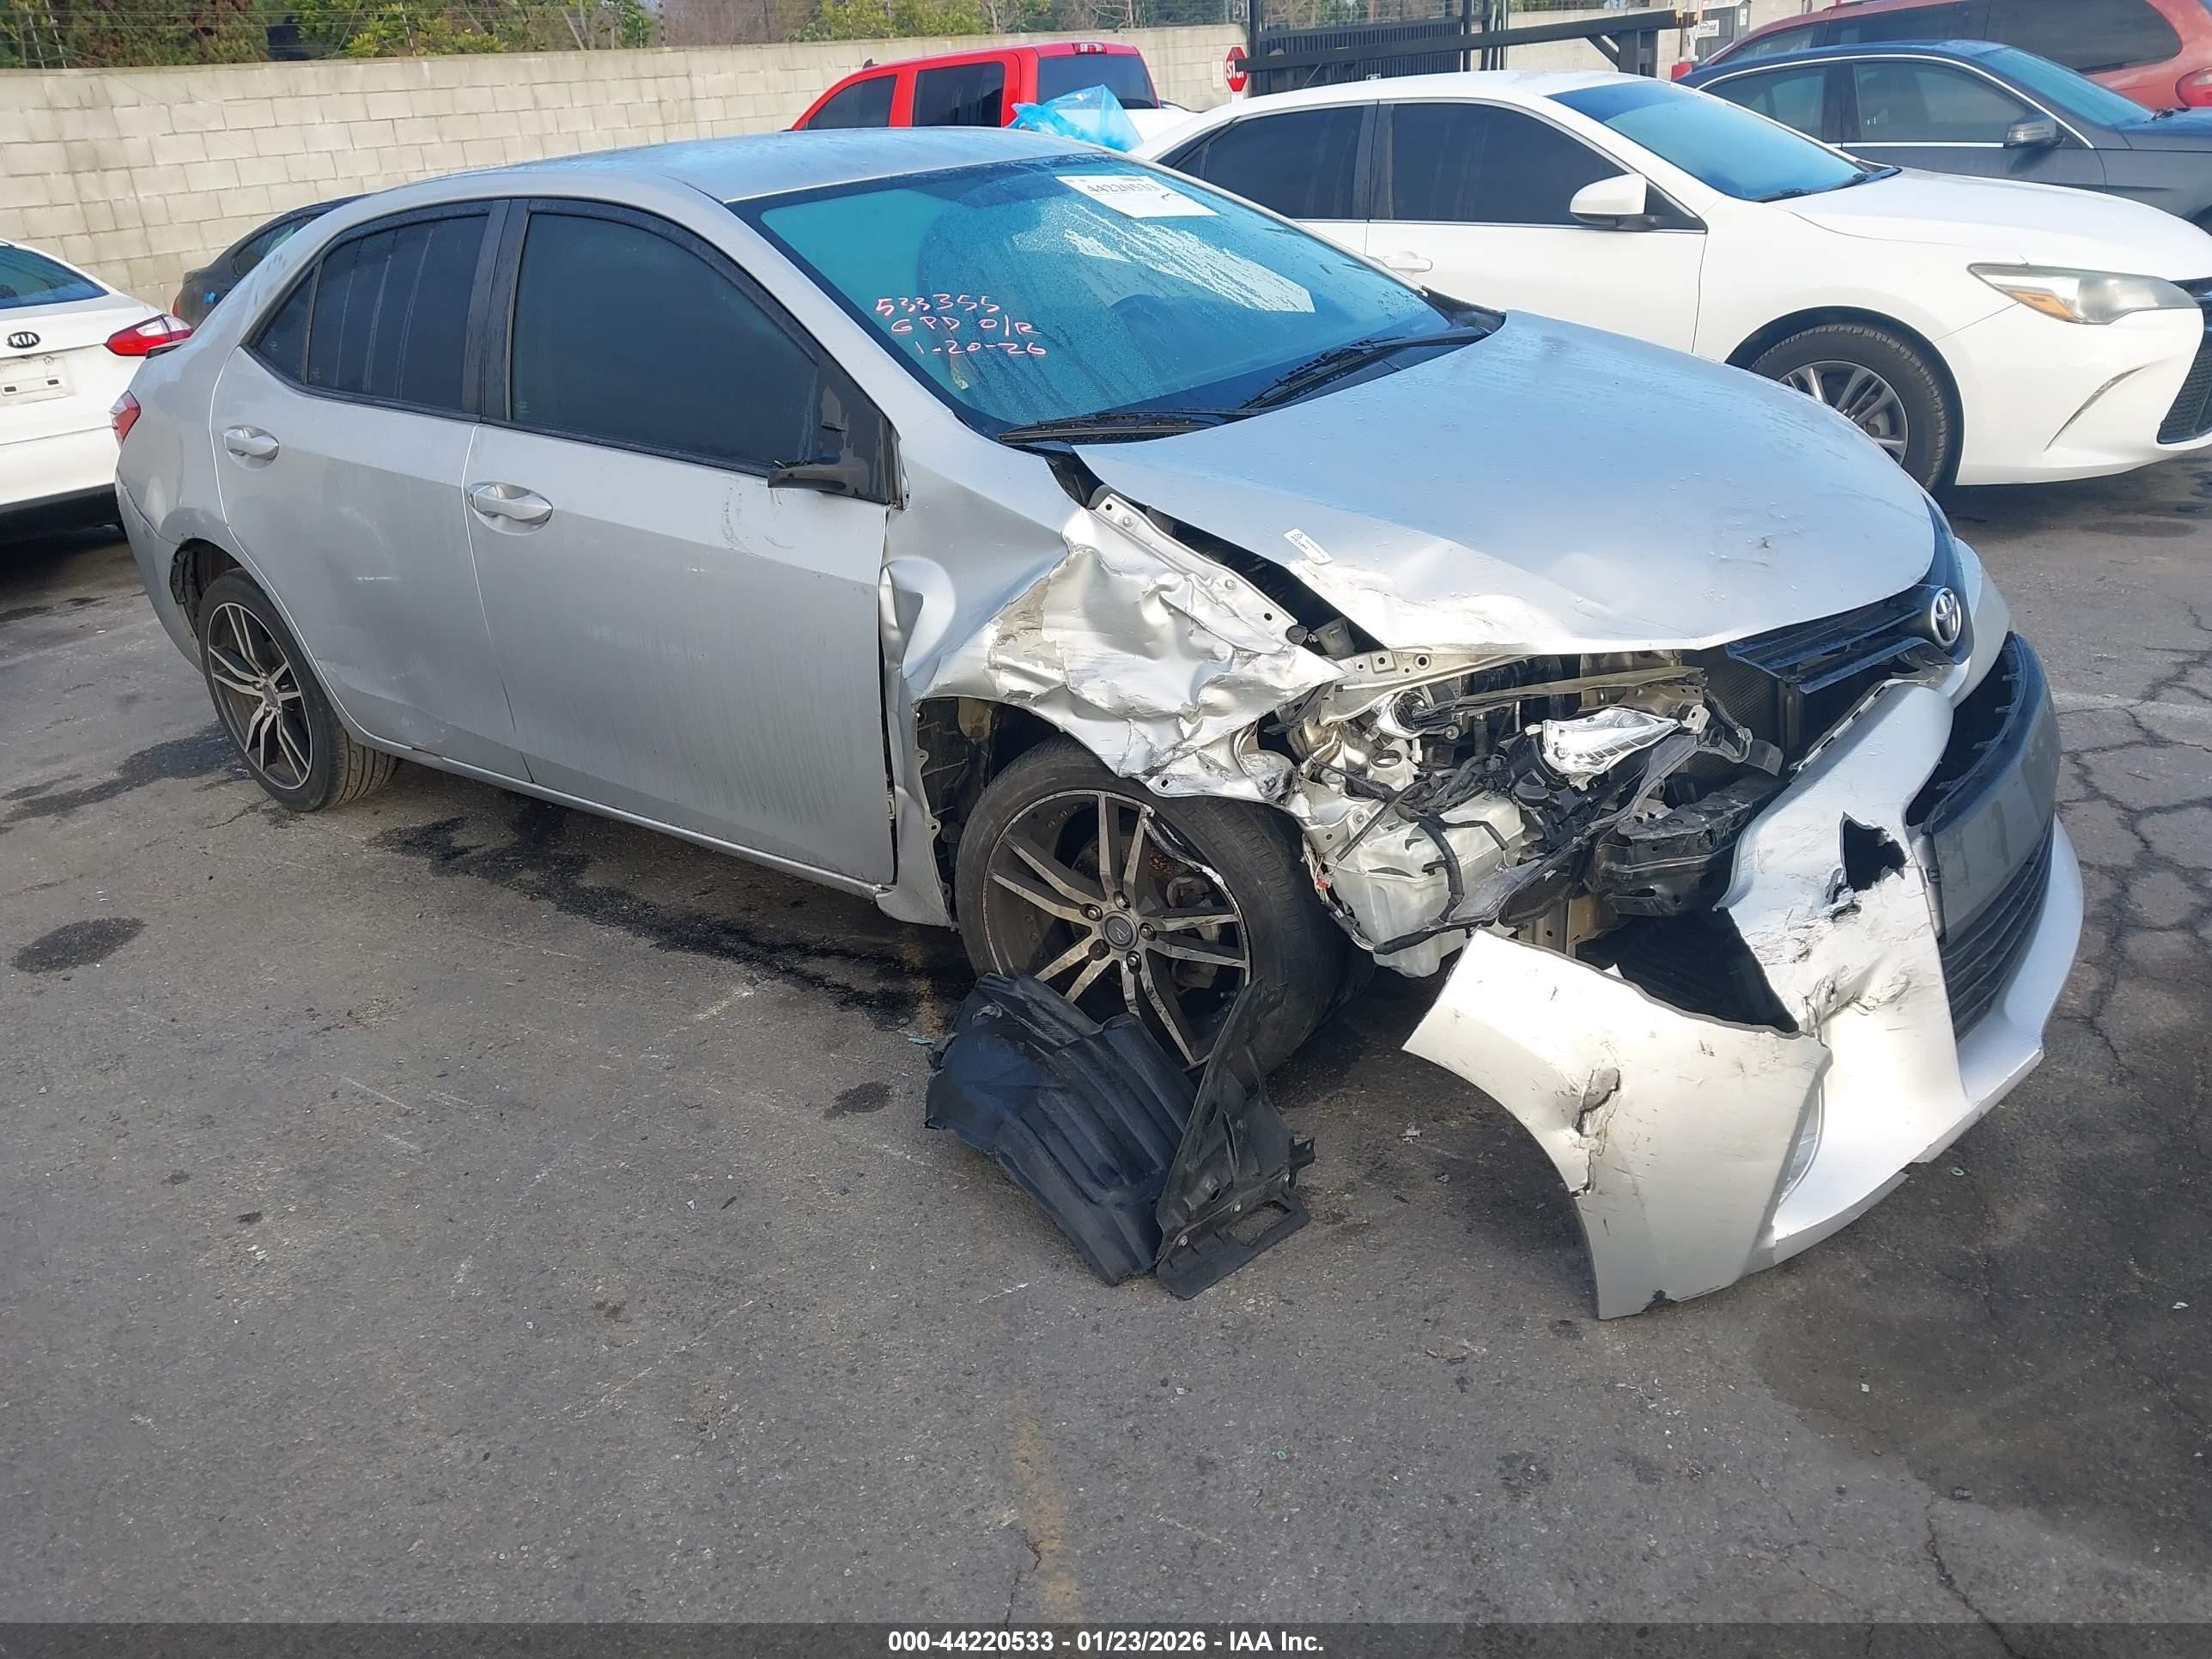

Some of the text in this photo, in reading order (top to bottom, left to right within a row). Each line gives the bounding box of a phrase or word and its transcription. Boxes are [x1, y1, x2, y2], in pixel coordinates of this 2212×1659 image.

[1226, 59, 1244, 79] ST
[10, 334, 37, 346] KIA
[915, 340, 1046, 356] 1-20-26
